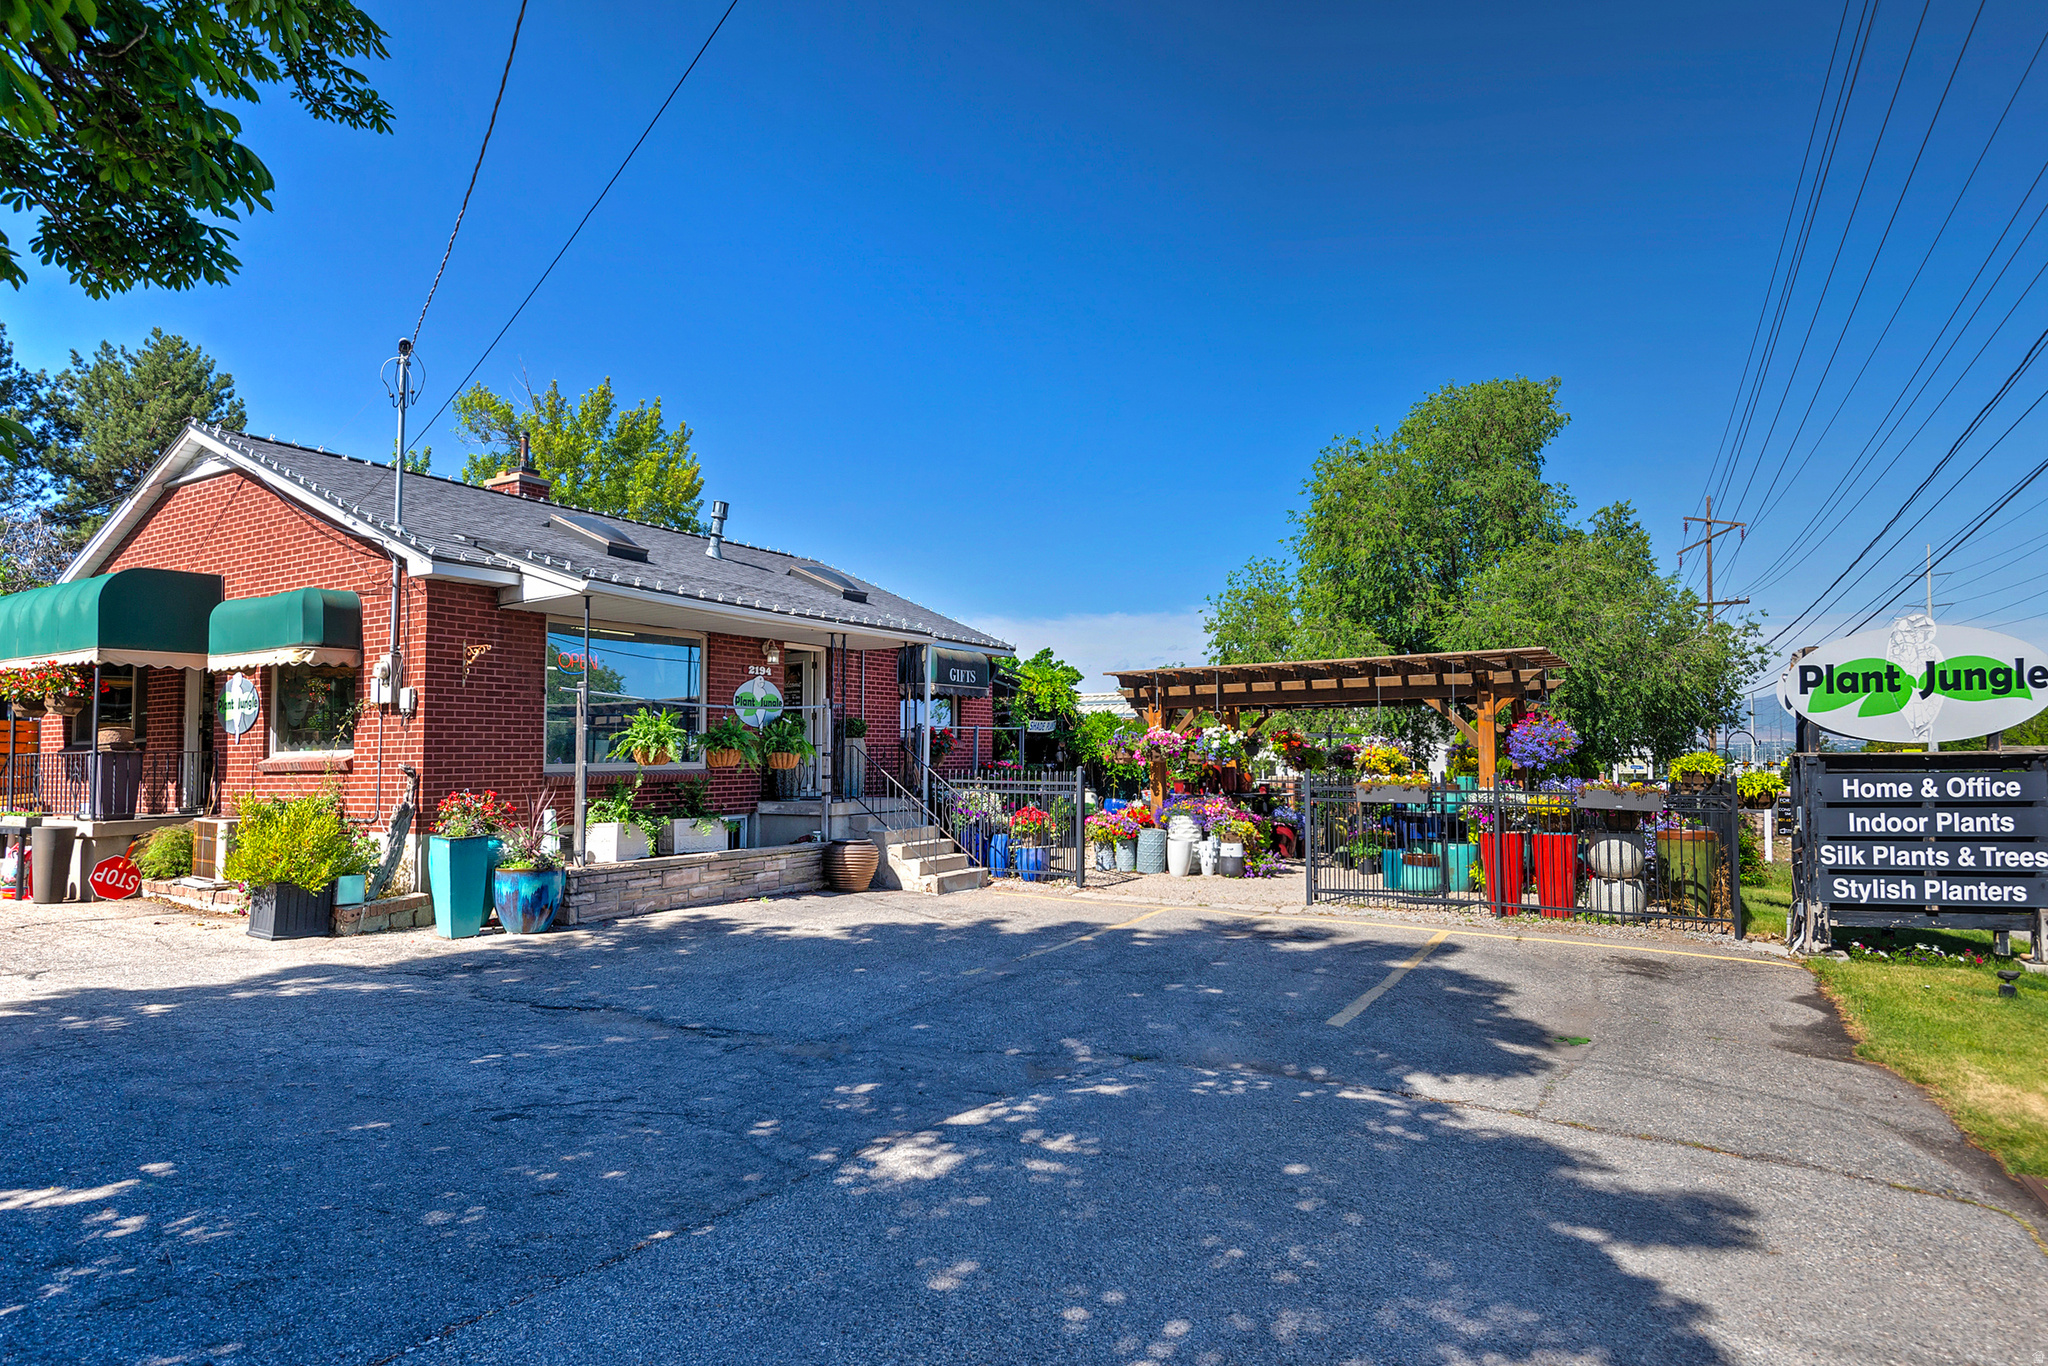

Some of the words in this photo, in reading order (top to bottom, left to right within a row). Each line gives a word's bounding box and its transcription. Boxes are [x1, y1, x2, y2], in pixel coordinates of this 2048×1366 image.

[558, 651, 598, 671] OPEN
[748, 665, 772, 676] 2194
[949, 667, 977, 684] GIFTS
[1798, 663, 1901, 696] Plant
[1919, 657, 2048, 701] Jungle
[237, 695, 258, 711] Jungle
[734, 695, 756, 707] Plant
[760, 697, 783, 708] Jungle
[1029, 721, 1045, 731] SHADE
[1842, 778, 1913, 798] Home
[1920, 777, 1939, 798] &
[1946, 776, 2022, 798] Office
[1848, 812, 1929, 833] Indoor
[1936, 812, 2016, 833] Plants
[1820, 844, 1866, 866] Silk
[1872, 845, 1950, 866] Plants
[1957, 846, 1977, 867] &
[1979, 846, 2048, 868] Trees
[93, 866, 139, 890] STOP
[1832, 877, 1916, 904] Stylish
[1924, 879, 2028, 902] Planters
